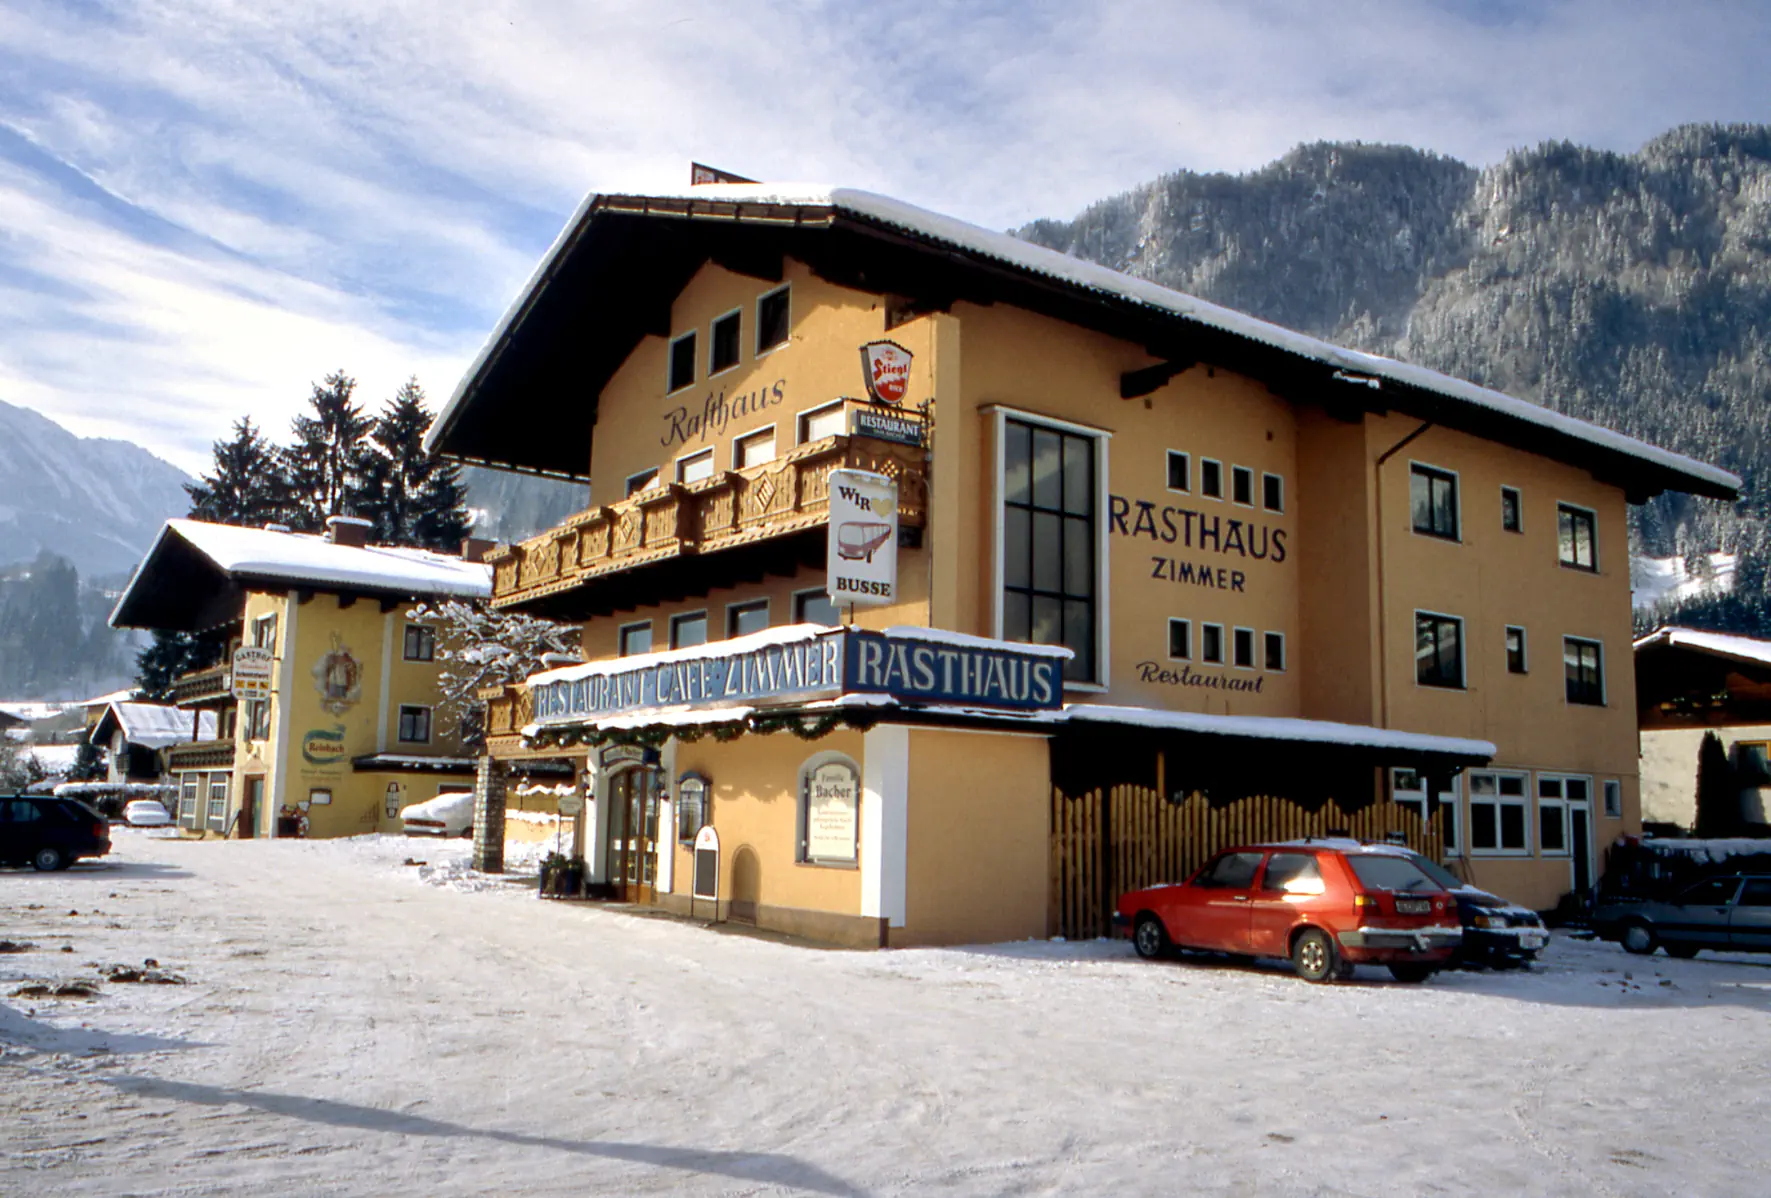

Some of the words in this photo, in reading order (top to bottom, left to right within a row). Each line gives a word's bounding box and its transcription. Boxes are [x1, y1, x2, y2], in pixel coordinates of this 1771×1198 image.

[873, 358, 907, 381] Stiegl
[860, 415, 919, 437] RESTAURANT
[838, 485, 871, 511] WIR
[1108, 494, 1287, 563] RASTHAUS
[836, 576, 892, 597] BUSSE
[1151, 556, 1246, 593] ZIMMER
[537, 669, 648, 718] RESTAURANT
[724, 639, 839, 695] ZIMMER
[857, 639, 1053, 704] RASTHAUS
[1136, 661, 1265, 693] Restaurant
[815, 784, 851, 799] Bacher
